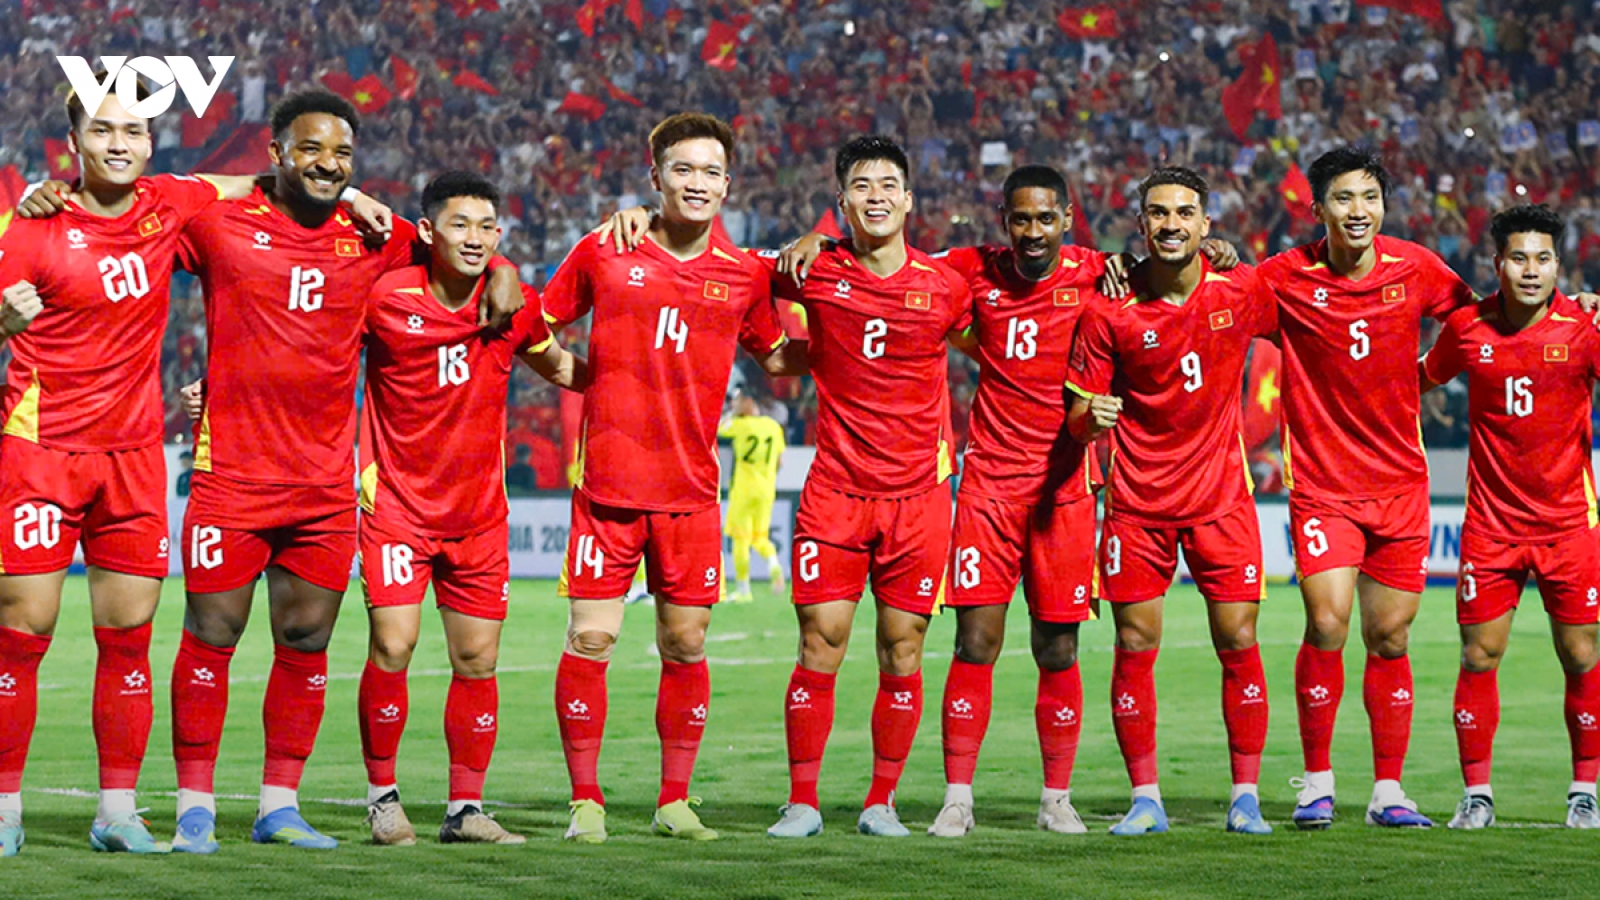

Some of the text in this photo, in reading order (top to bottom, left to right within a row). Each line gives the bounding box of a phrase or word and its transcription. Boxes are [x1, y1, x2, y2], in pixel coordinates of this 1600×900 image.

[97, 251, 150, 303] 20
[287, 265, 325, 313] 12
[655, 305, 689, 354] 14
[862, 318, 888, 360] 2
[1005, 316, 1039, 361] 13
[1349, 319, 1370, 361] 5
[437, 343, 470, 388] 18
[1180, 351, 1203, 393] 9
[1505, 375, 1533, 418] 15
[743, 434, 773, 465] 21
[14, 502, 63, 551] 20
[191, 524, 224, 570] 12
[1303, 517, 1329, 558] 5
[381, 543, 414, 587] 18
[575, 534, 605, 579] 14
[800, 540, 820, 583] 2
[954, 546, 981, 590] 13
[1105, 535, 1122, 577] 9
